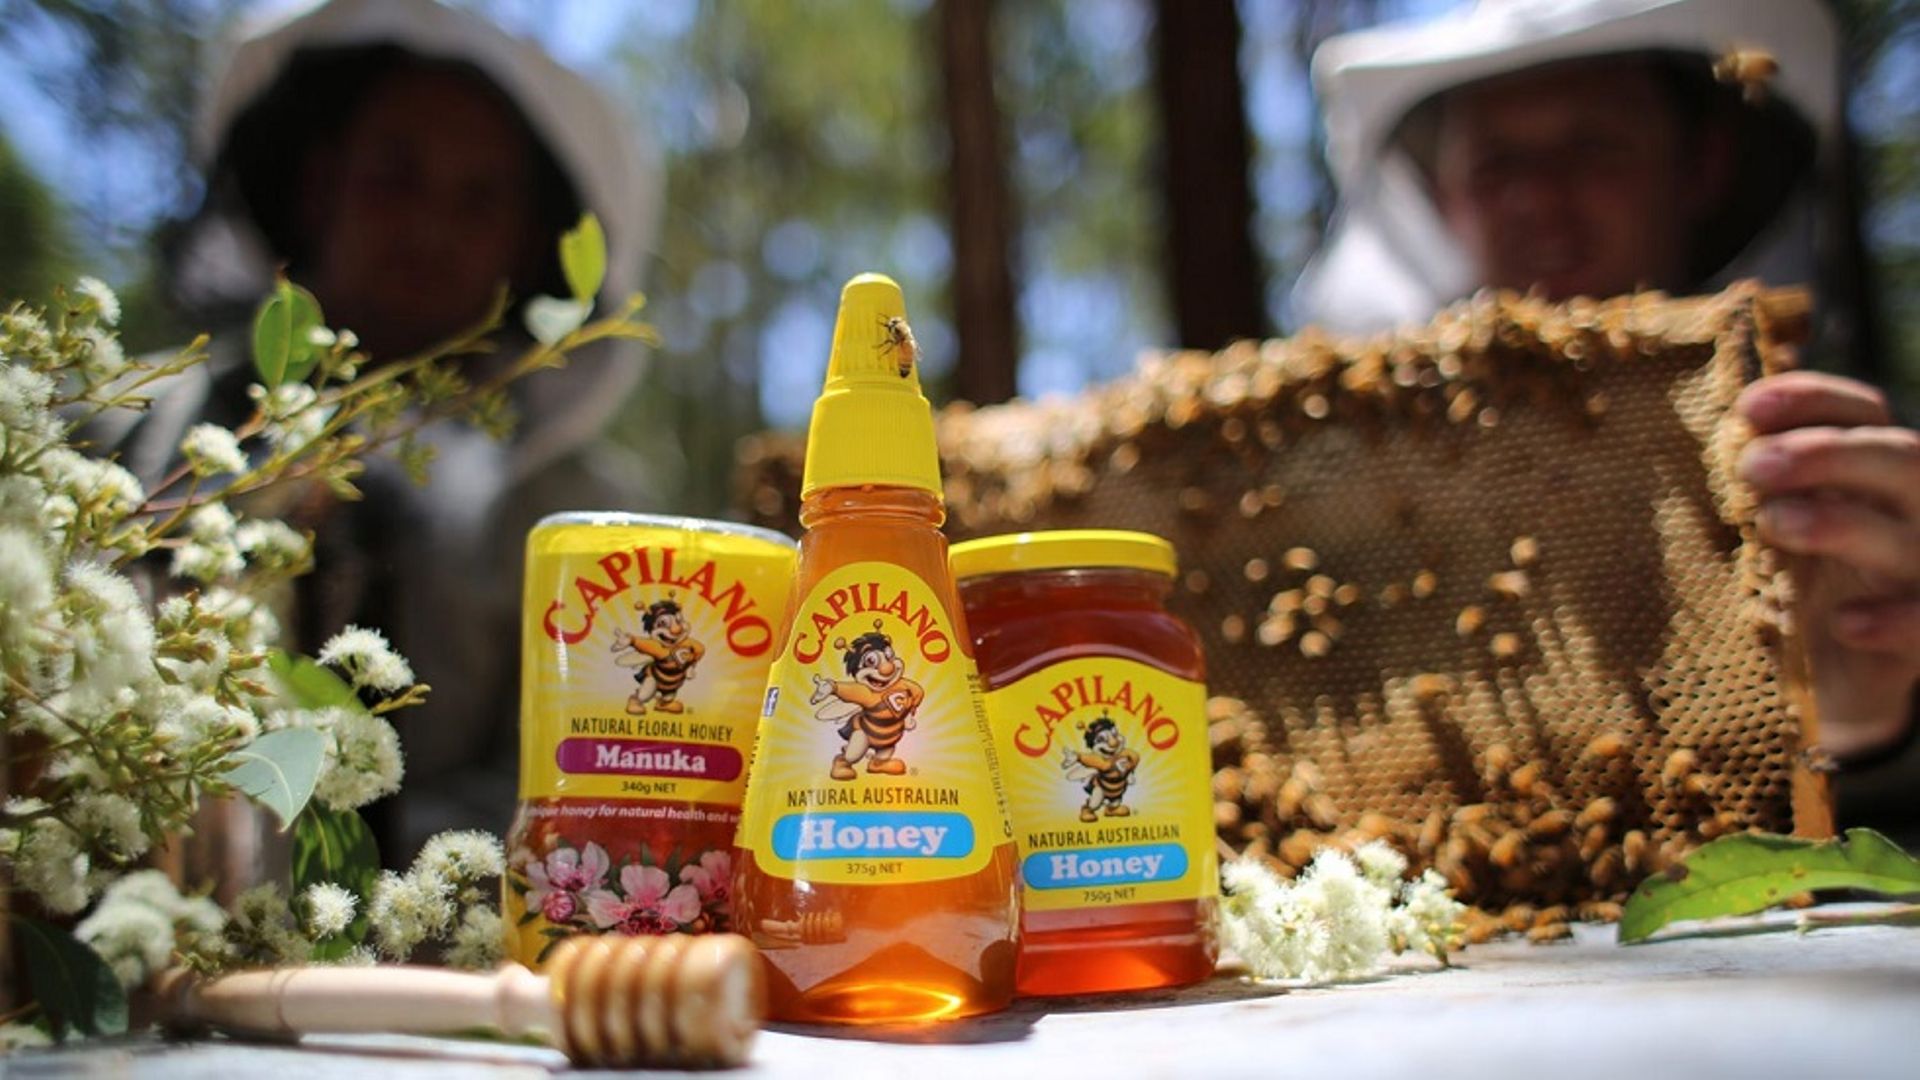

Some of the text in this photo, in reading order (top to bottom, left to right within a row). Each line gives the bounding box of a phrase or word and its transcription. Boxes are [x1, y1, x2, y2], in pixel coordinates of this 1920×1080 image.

[543, 546, 772, 658] CAPILANO
[794, 582, 951, 664] CAPILANO
[1013, 675, 1180, 758] CAPILANO
[571, 717, 733, 742] NATURAL FLORAL HONEY
[595, 743, 706, 773] Manuka
[620, 780, 677, 794] 340g NET
[787, 787, 959, 807] NATURAL AUSTRALIAN
[560, 804, 599, 818] honey
[600, 804, 617, 816] for
[618, 805, 666, 818] natural
[667, 806, 705, 821] health
[706, 811, 730, 823] and
[800, 818, 948, 857] Honey
[1028, 824, 1180, 848] NATURAL AUSTRALIAN
[846, 862, 903, 876] 375g NET
[1050, 854, 1163, 880] Honey
[1082, 887, 1136, 904] 750g NET
